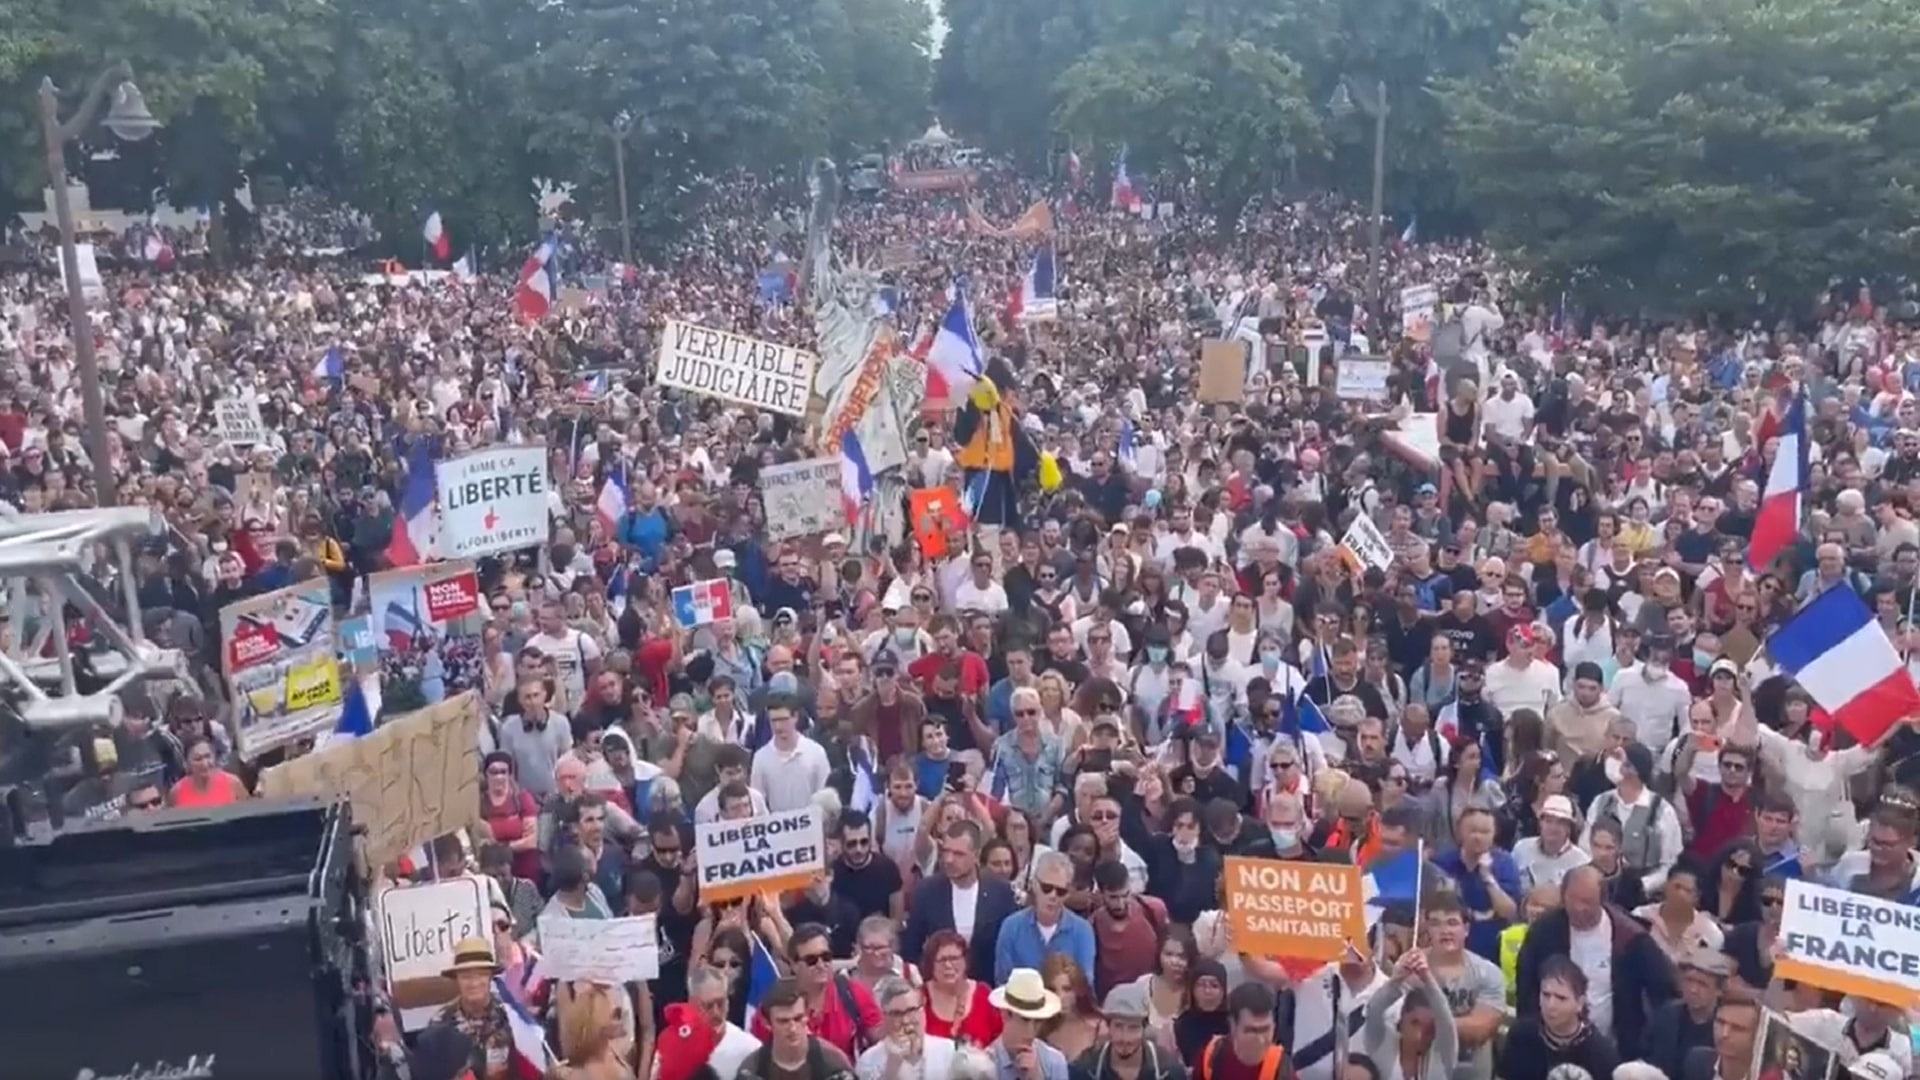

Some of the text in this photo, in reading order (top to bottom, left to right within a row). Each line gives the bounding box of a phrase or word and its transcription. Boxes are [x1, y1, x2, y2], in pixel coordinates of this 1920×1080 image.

[675, 323, 809, 380] VERITABLE
[665, 356, 807, 411] JUDICIAIRE
[448, 466, 543, 510] LIBERTÉ
[430, 581, 460, 595] NON
[744, 838, 771, 853] LA
[705, 846, 816, 882] FRANCE!
[1238, 865, 1347, 895] NON AU
[1233, 892, 1354, 919] PASSEPORT
[387, 907, 472, 962] Liberté
[1246, 915, 1342, 938] SANITAIRE
[1841, 920, 1876, 941] LA
